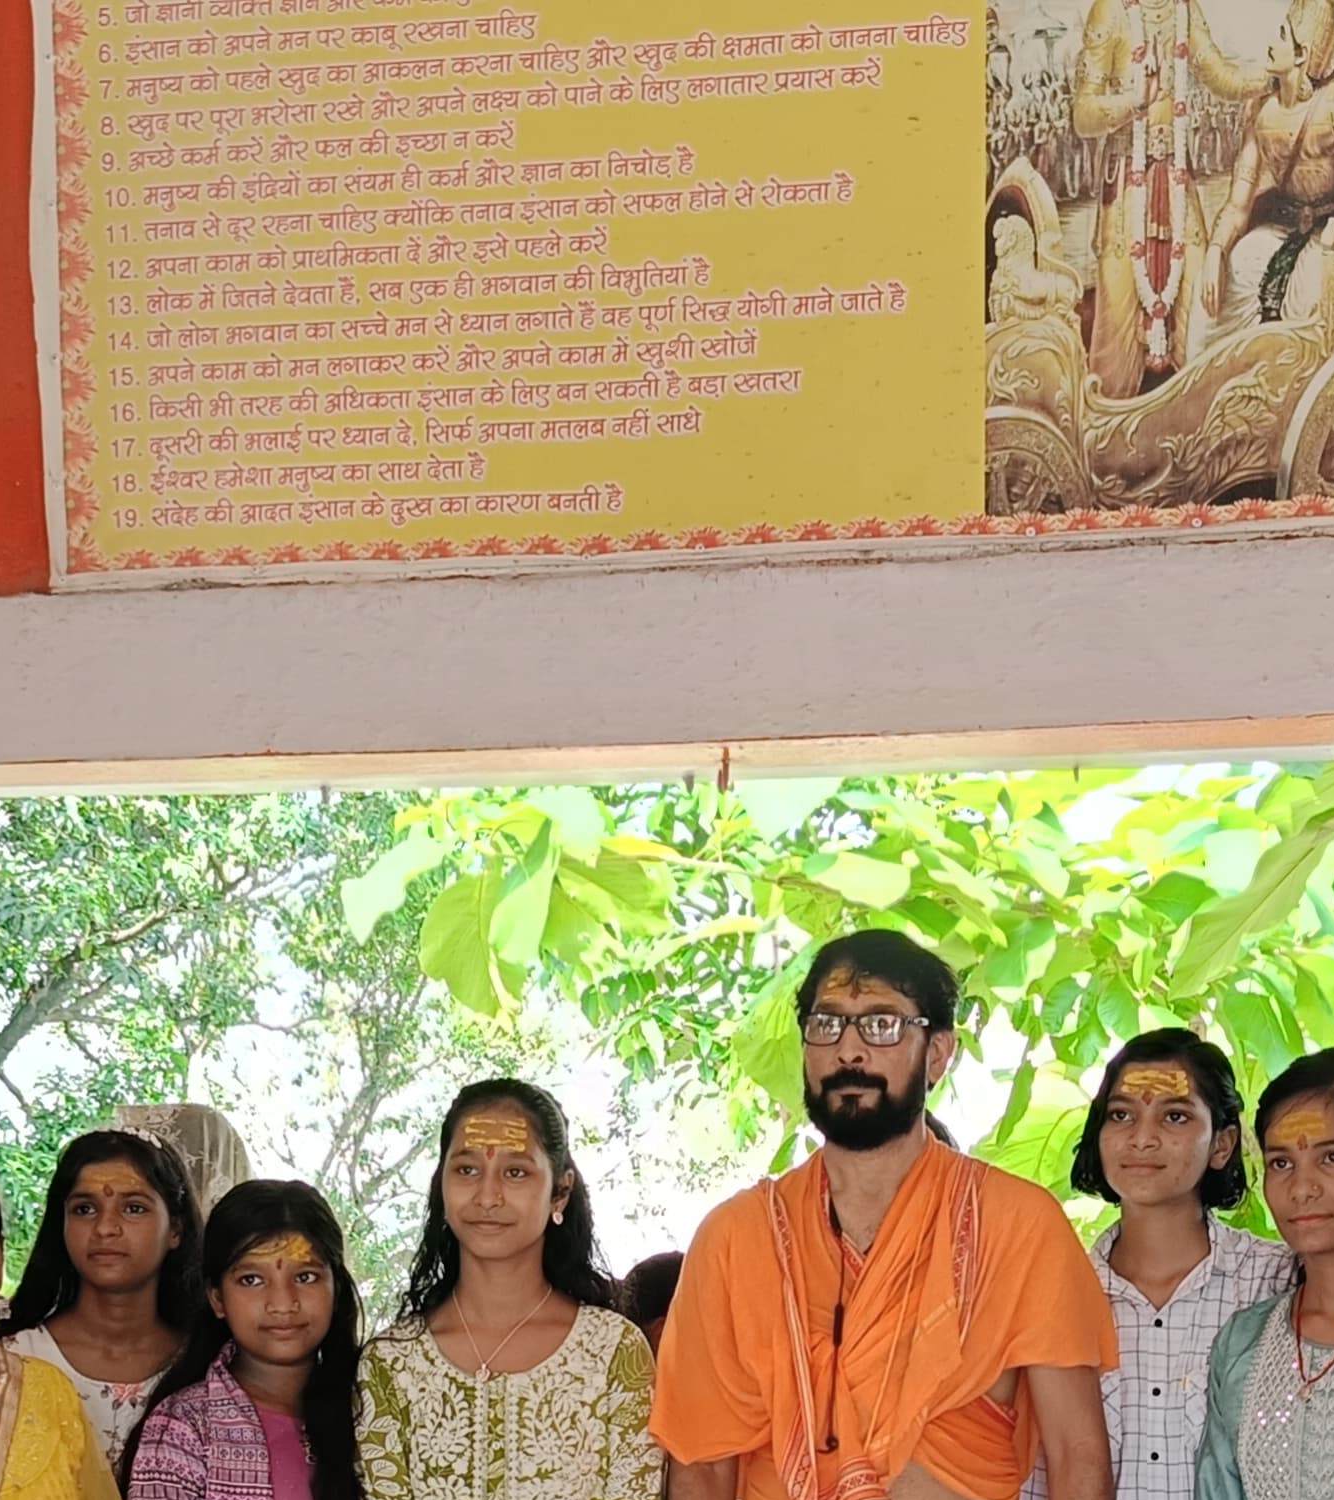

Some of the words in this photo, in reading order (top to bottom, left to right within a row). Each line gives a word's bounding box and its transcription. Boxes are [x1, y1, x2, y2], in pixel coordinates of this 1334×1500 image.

[101, 7, 118, 27] 5.
[101, 43, 118, 64] 6.
[124, 34, 183, 66] इंसान
[186, 29, 219, 56] को
[224, 25, 273, 57] अपने
[277, 30, 312, 51] मन
[316, 27, 345, 49] पर
[350, 24, 401, 50] काबू
[399, 19, 470, 50] रखना
[474, 8, 538, 40] चाहिए
[101, 79, 120, 99] 7.
[126, 75, 185, 105] मनुष्य
[189, 65, 220, 91] को
[224, 62, 273, 91] पहले
[278, 66, 322, 96] खुद
[326, 64, 358, 83] का
[362, 58, 446, 84] आकलन
[450, 53, 514, 76] करना
[518, 42, 581, 74] चाहिए
[586, 38, 627, 70] और
[633, 42, 679, 72] खुद
[683, 31, 717, 59] की
[722, 34, 785, 59] क्षमता
[790, 23, 824, 52] को
[828, 26, 898, 49] जानना
[903, 14, 970, 47] चाहिए
[101, 152, 121, 173] 9.
[180, 137, 222, 165] कर्म
[226, 135, 263, 164] करें
[270, 134, 309, 163] और
[314, 138, 354, 159] फल
[358, 128, 391, 155] की
[395, 132, 448, 159] इच्छा
[453, 130, 471, 149] न
[475, 119, 514, 149] करें
[105, 187, 136, 208] 10.
[143, 183, 202, 213] मनुष्य
[206, 174, 237, 199] की
[306, 175, 338, 194] का
[343, 166, 396, 194] संयम
[400, 163, 423, 191] ही
[428, 159, 470, 188] कर्म
[474, 158, 515, 188] और
[521, 162, 565, 185] ज्ञान
[570, 159, 602, 179] का
[607, 148, 672, 179] निचोड़
[676, 145, 695, 175] है
[107, 259, 138, 280] 12.
[145, 255, 201, 279] अपना
[205, 253, 252, 273] काम
[257, 243, 288, 270] को
[292, 240, 401, 270] प्राथमिकता
[406, 236, 422, 265] दें
[427, 234, 467, 264] और
[472, 231, 510, 265] इसे
[514, 228, 564, 258] पहले
[568, 225, 608, 255] करें
[107, 295, 139, 316] 13.
[146, 286, 194, 315] लोक
[198, 283, 216, 311] में
[221, 280, 278, 309] जितने
[282, 279, 335, 307] देवता
[368, 281, 404, 302] सब
[409, 279, 449, 305] एक
[453, 270, 476, 299] ही
[481, 273, 559, 296] भगवान
[563, 264, 596, 291] की
[691, 256, 711, 286] है
[108, 366, 140, 387] 15.
[148, 357, 196, 387] अपने
[201, 361, 248, 381] काम
[252, 352, 284, 379] को
[288, 358, 321, 378] मन
[326, 353, 406, 377] लगाकर
[411, 344, 450, 373] करें
[456, 343, 496, 372] और
[502, 339, 553, 370] अपने
[558, 345, 606, 365] काम
[611, 335, 630, 364] में
[636, 332, 696, 370] खुशी
[700, 327, 758, 359] खोजें
[110, 402, 141, 423] 16.
[148, 392, 204, 420] किसी
[209, 390, 236, 417] भी
[239, 395, 284, 417] तरह
[288, 386, 319, 413] की
[324, 384, 413, 414] अधिकता
[416, 381, 476, 413] इंसान
[480, 378, 506, 405] के
[511, 377, 551, 409] लिए
[556, 382, 590, 402] बन
[594, 371, 661, 401] सकती
[664, 369, 682, 399] है
[687, 374, 728, 399] बड़ा
[733, 370, 802, 394] खतरा
[111, 437, 142, 458] 17.
[208, 426, 239, 452] की
[244, 422, 303, 454] भलाई
[307, 428, 337, 449] पर
[341, 426, 392, 446] ध्यान
[425, 415, 474, 444] सिर्फ
[478, 421, 536, 444] अपना
[540, 418, 607, 440] मतलब
[612, 408, 652, 437] नहीं
[656, 405, 702, 434] साधे
[112, 473, 143, 493] 18.
[214, 461, 274, 489] हमेशा
[278, 464, 337, 493] मनुष्य
[341, 463, 373, 482] का
[377, 462, 423, 482] साथ
[426, 453, 465, 481] देता
[467, 451, 486, 480] है
[112, 508, 144, 529] 19.
[151, 499, 199, 527] संदेह
[204, 497, 235, 523] की
[239, 502, 294, 525] आदत
[298, 493, 356, 525] इंसान
[360, 491, 386, 518] के
[390, 497, 435, 526] दुख
[439, 495, 471, 515] का
[475, 493, 543, 514] कारण
[547, 484, 603, 513] बनती
[604, 483, 624, 512] है
